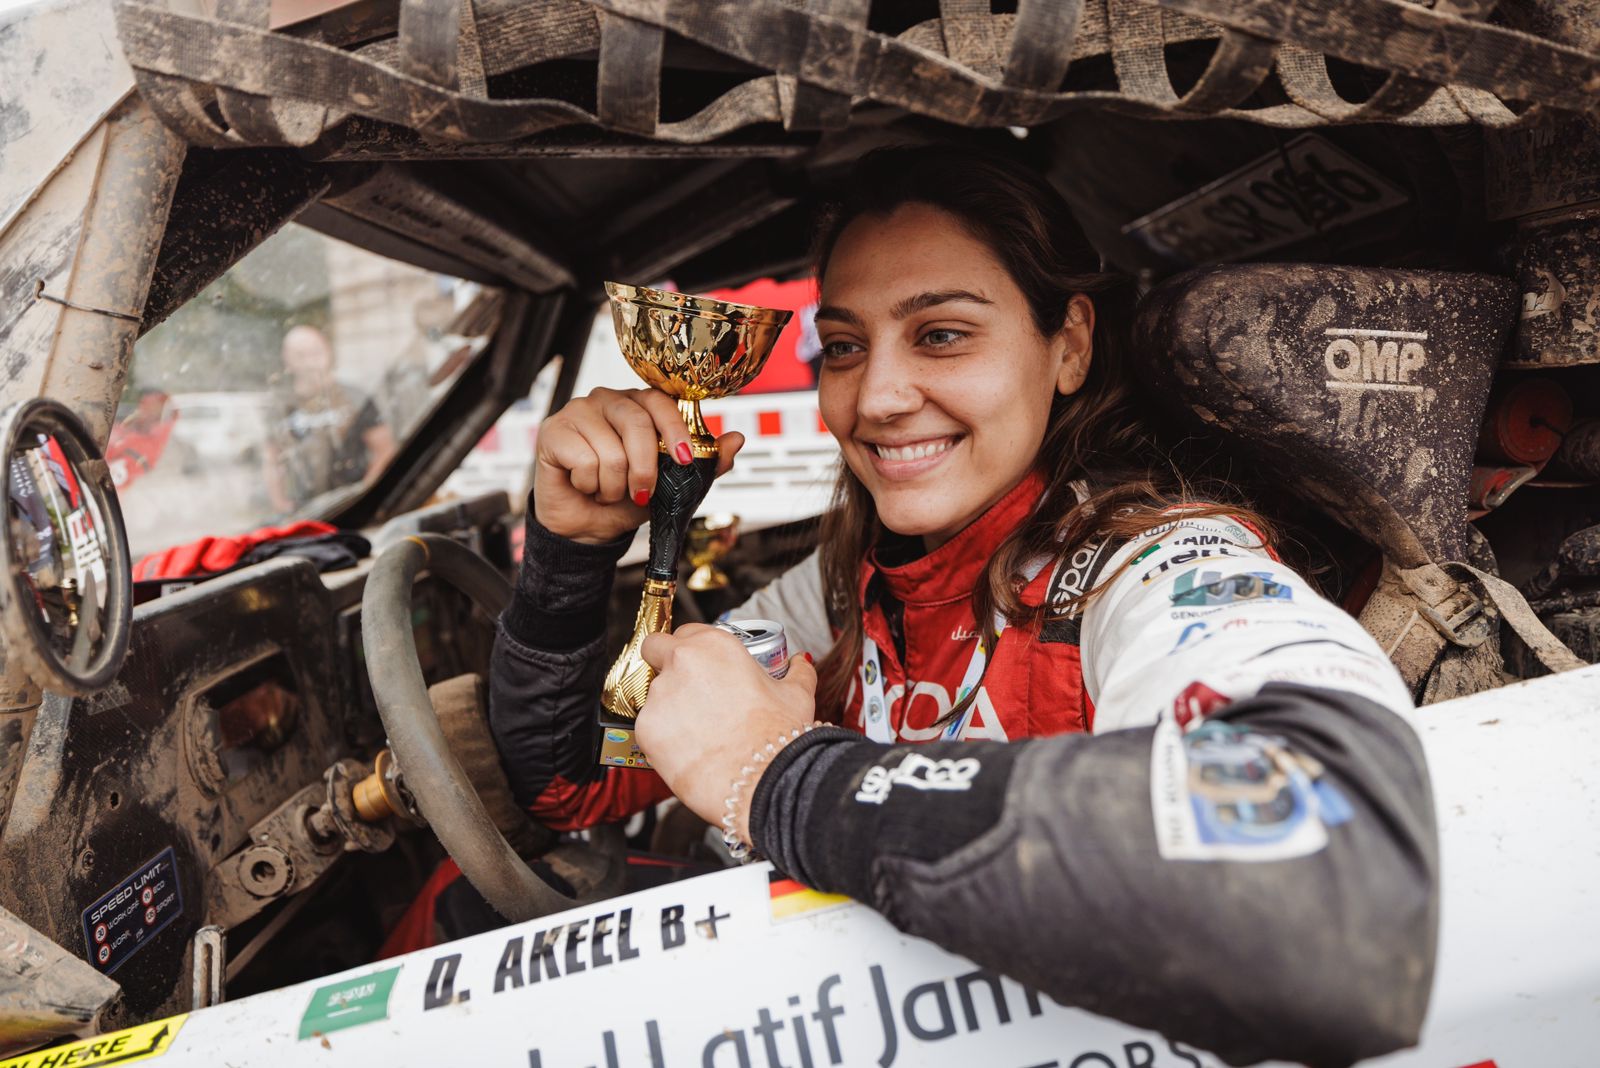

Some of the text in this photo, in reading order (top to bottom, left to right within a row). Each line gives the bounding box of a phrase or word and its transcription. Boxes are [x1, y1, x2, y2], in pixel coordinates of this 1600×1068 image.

[1325, 339, 1425, 382] OMP
[91, 863, 161, 925] SPEED LIMIT
[153, 880, 165, 894] ECO
[156, 892, 175, 914] SPORT
[107, 911, 127, 930] WORK
[110, 929, 132, 950] WORK
[493, 907, 640, 994] AKEEL
[868, 962, 1044, 1068] Jam
[39, 1034, 132, 1068] HERE
